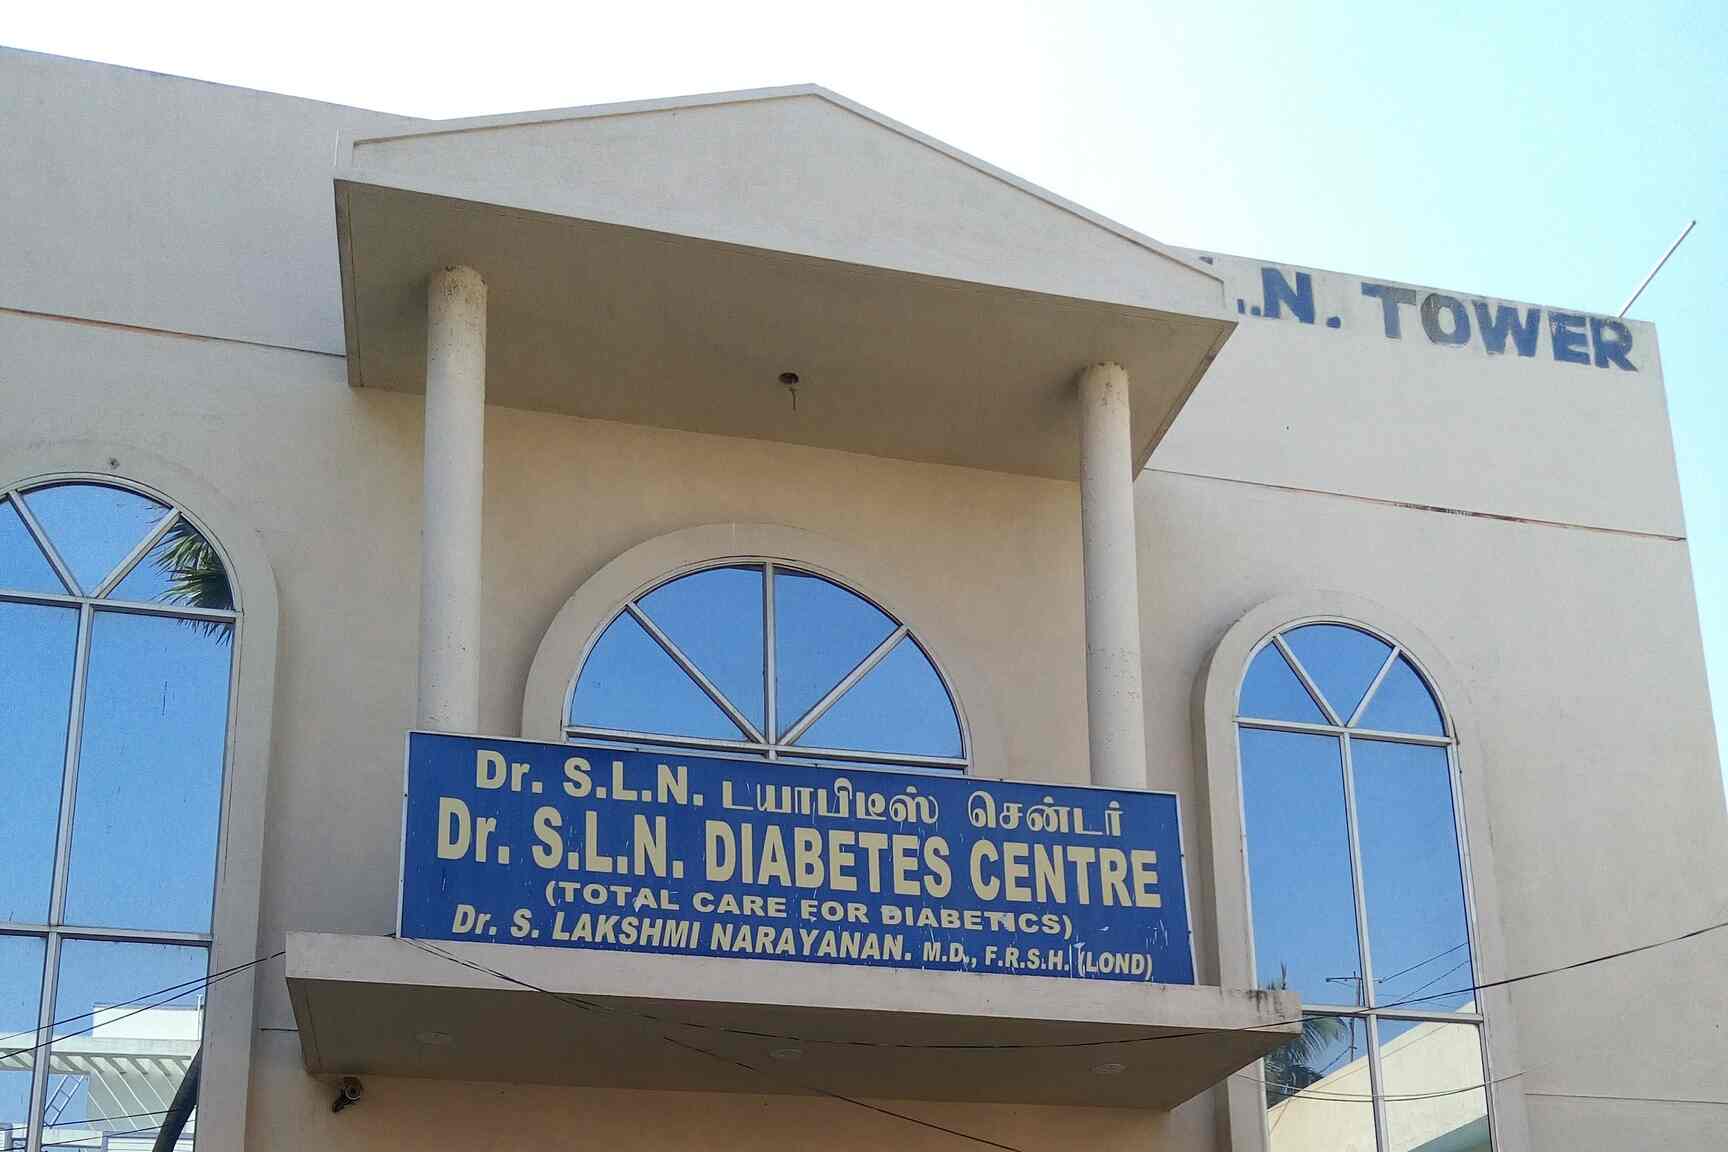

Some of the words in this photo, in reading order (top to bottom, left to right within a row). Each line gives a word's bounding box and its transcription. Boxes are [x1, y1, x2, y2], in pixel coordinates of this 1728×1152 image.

[1361, 281, 1638, 372] TOWER
[476, 750, 543, 793] Dr.
[563, 757, 704, 806] S.L.N.
[968, 790, 1124, 838] சென்டர்
[437, 796, 511, 865] Dr.
[531, 806, 684, 879] S.L.N.
[704, 819, 952, 899] DIABETES
[970, 840, 1162, 909] CENTRE
[452, 904, 497, 936] Dr.
[510, 908, 540, 938] S.
[551, 911, 701, 949] LAKSHMI
[710, 922, 912, 961] NARAYANAN.
[1078, 952, 1153, 981] (LOND)
[545, 880, 680, 911] (TOTAL
[693, 891, 787, 918] CARE
[800, 900, 869, 924] FOR
[881, 906, 1073, 940] DIABETICS)
